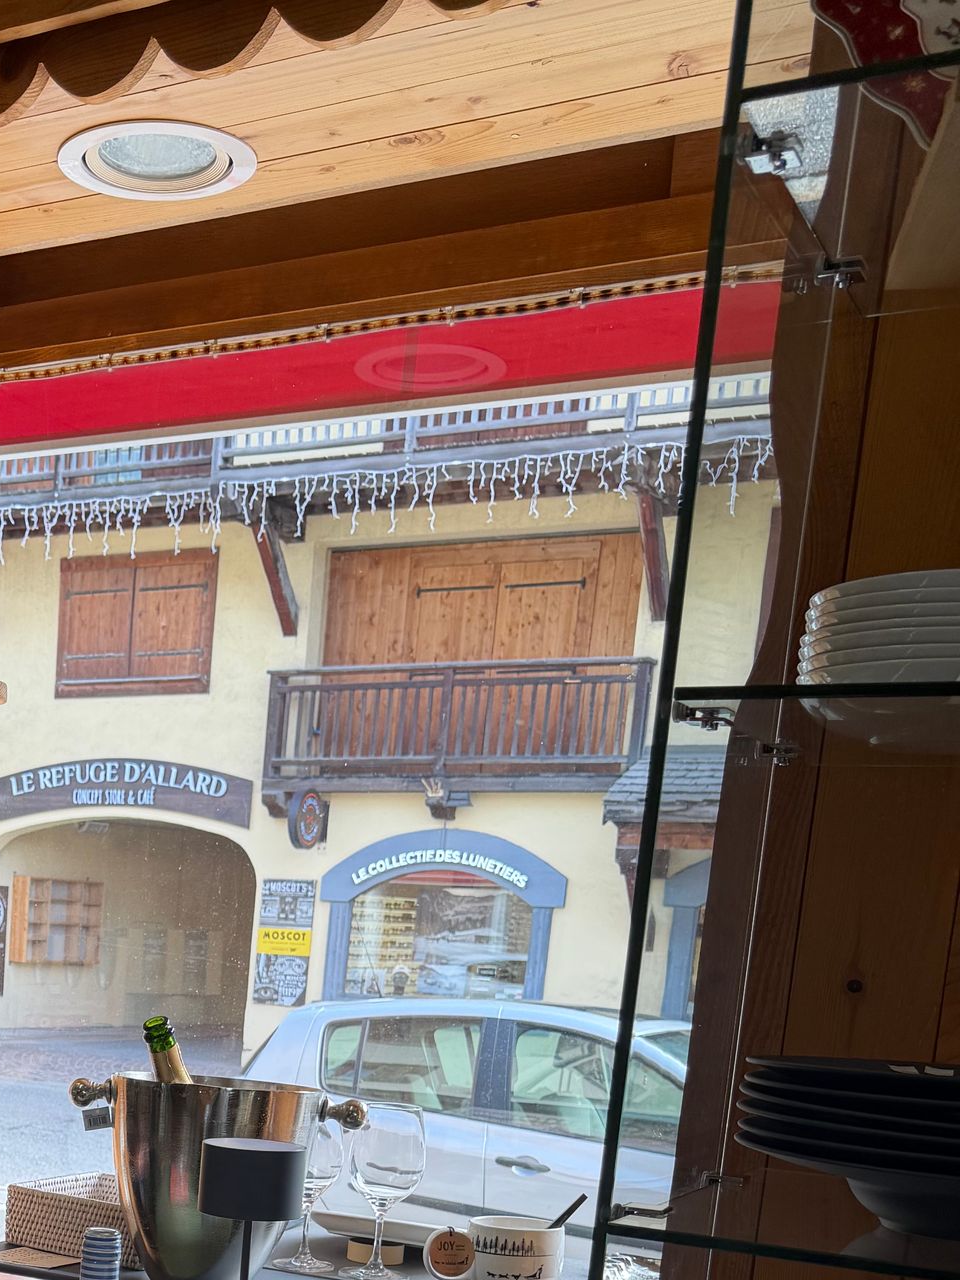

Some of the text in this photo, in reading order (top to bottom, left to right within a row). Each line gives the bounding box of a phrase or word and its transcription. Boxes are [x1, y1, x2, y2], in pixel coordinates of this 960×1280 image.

[9, 761, 228, 798] LE REFUGE D'ALLARD
[351, 866, 370, 885] LE
[435, 849, 460, 864] DES
[461, 851, 529, 888] LUNETIERS
[263, 930, 306, 942] MOSCOT
[437, 1240, 456, 1251] JOY
